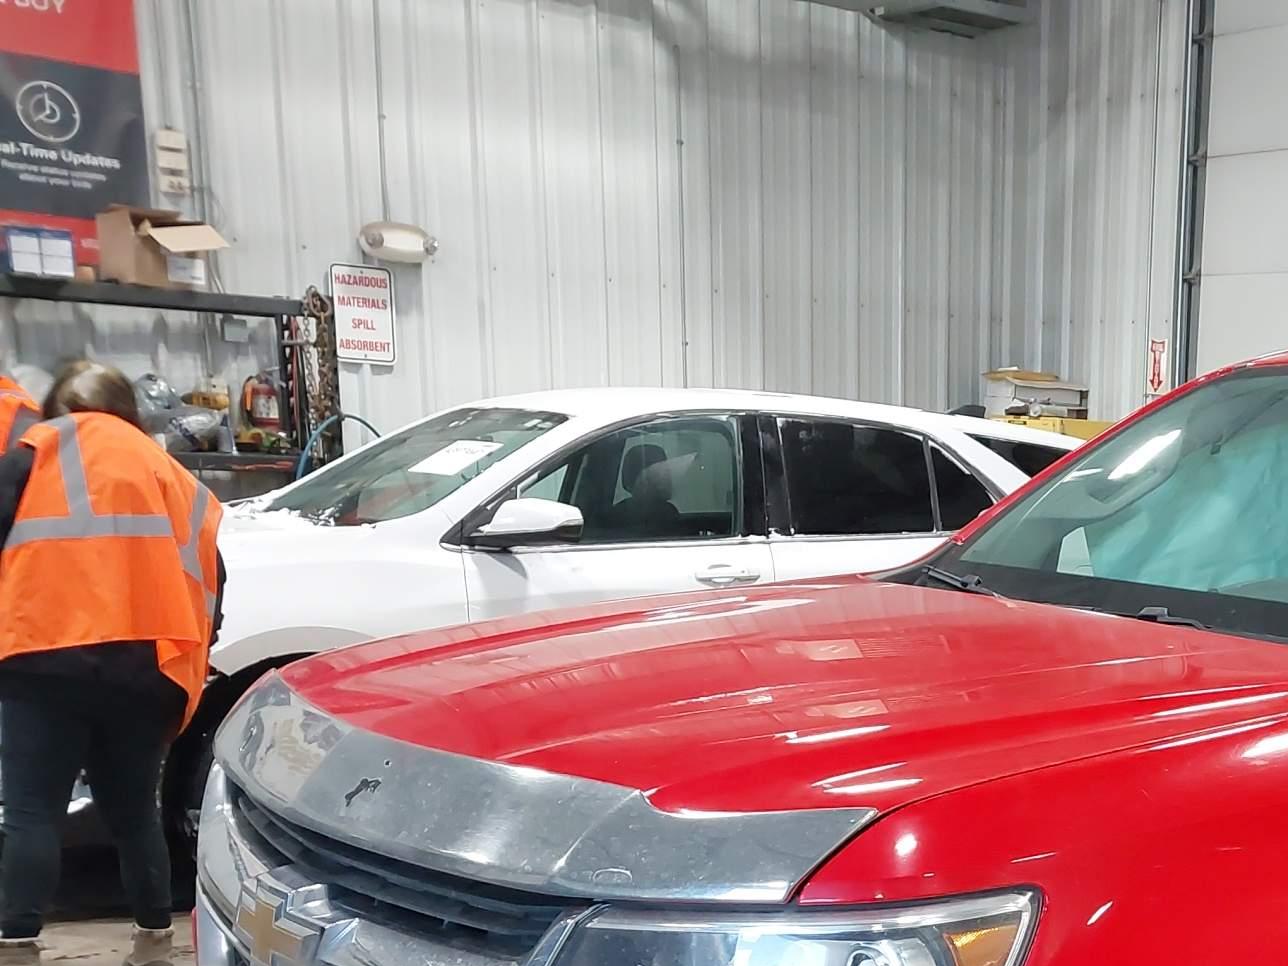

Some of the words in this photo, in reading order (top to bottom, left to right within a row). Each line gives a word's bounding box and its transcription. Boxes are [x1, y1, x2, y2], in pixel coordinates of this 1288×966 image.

[0, 141, 58, 160] al-Time
[60, 149, 121, 169] Updates
[334, 273, 388, 289] HAZARDOUS
[337, 295, 388, 310] MATERIALS
[351, 318, 376, 331] SPILL
[338, 338, 390, 353] ABSORBENT
